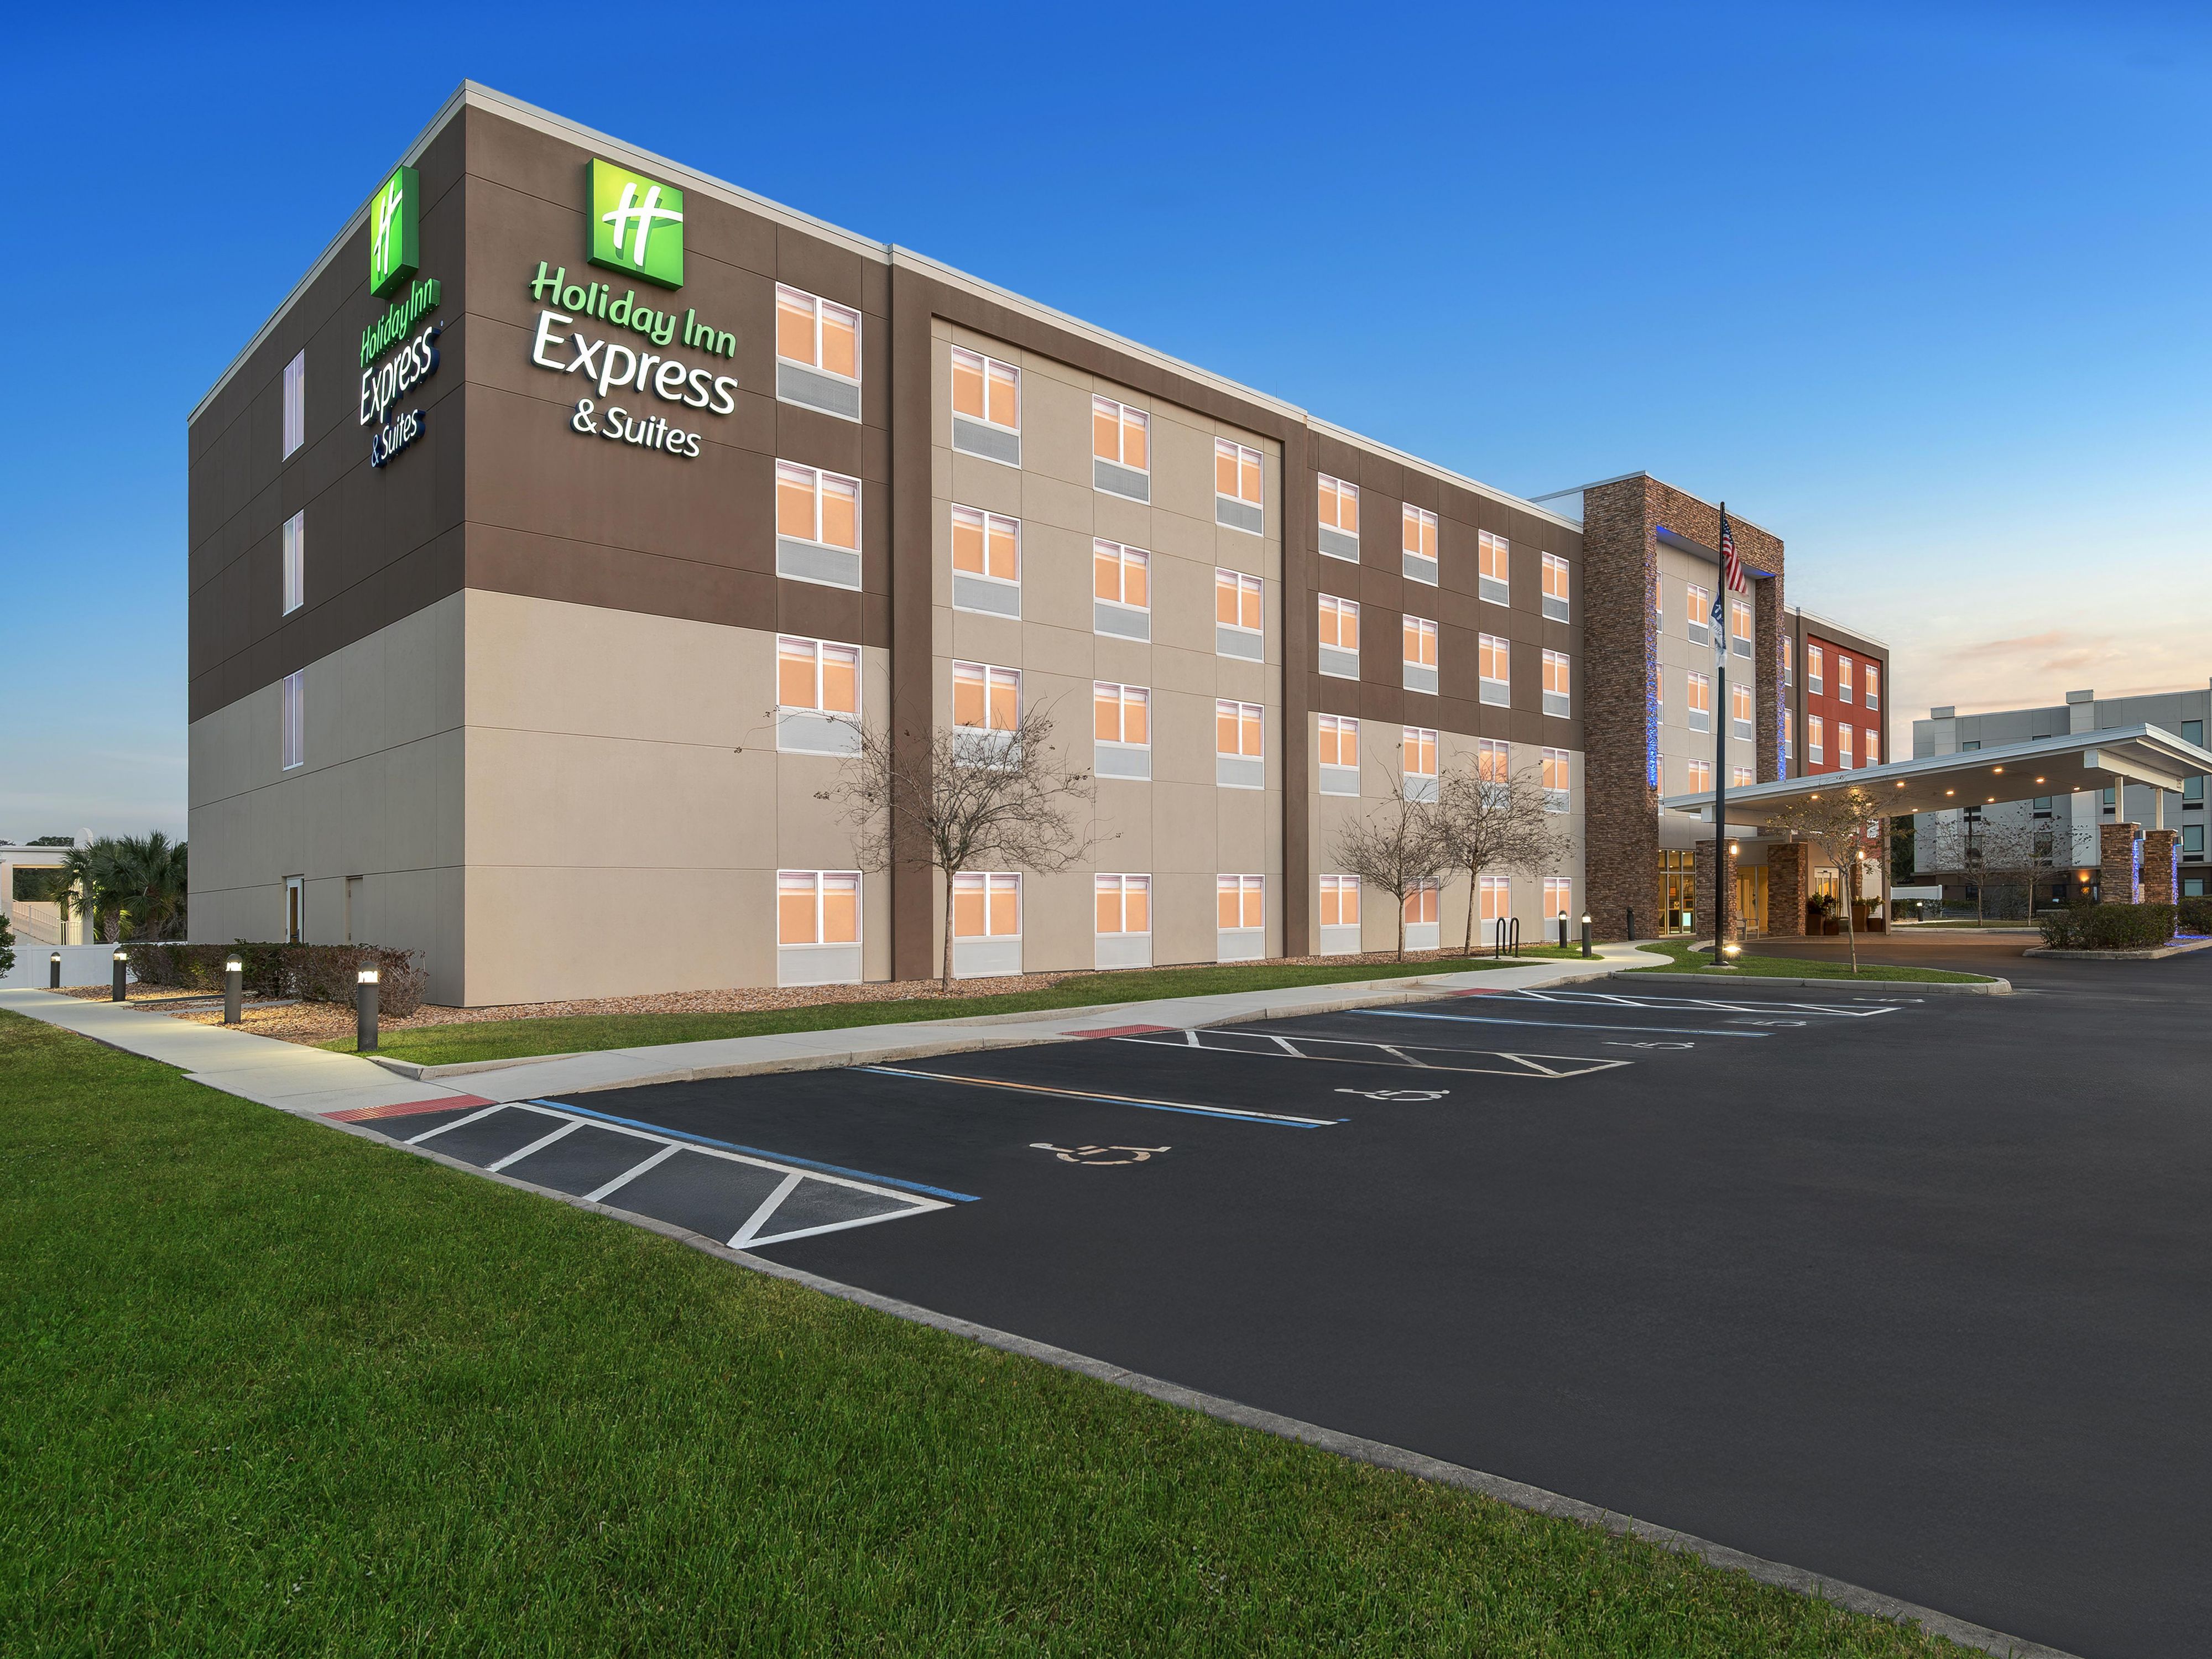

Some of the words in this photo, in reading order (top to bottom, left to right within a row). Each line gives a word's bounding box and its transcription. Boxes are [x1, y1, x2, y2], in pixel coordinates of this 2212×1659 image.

[359, 299, 409, 368] Holiday
[410, 278, 433, 321] Inn
[531, 260, 677, 346] Holiday
[682, 307, 737, 358] Inn
[360, 326, 432, 426] Express
[533, 309, 739, 415] Express
[371, 434, 379, 467] &
[381, 409, 418, 460] Suites
[572, 398, 597, 434] &
[601, 406, 702, 458] Suites
